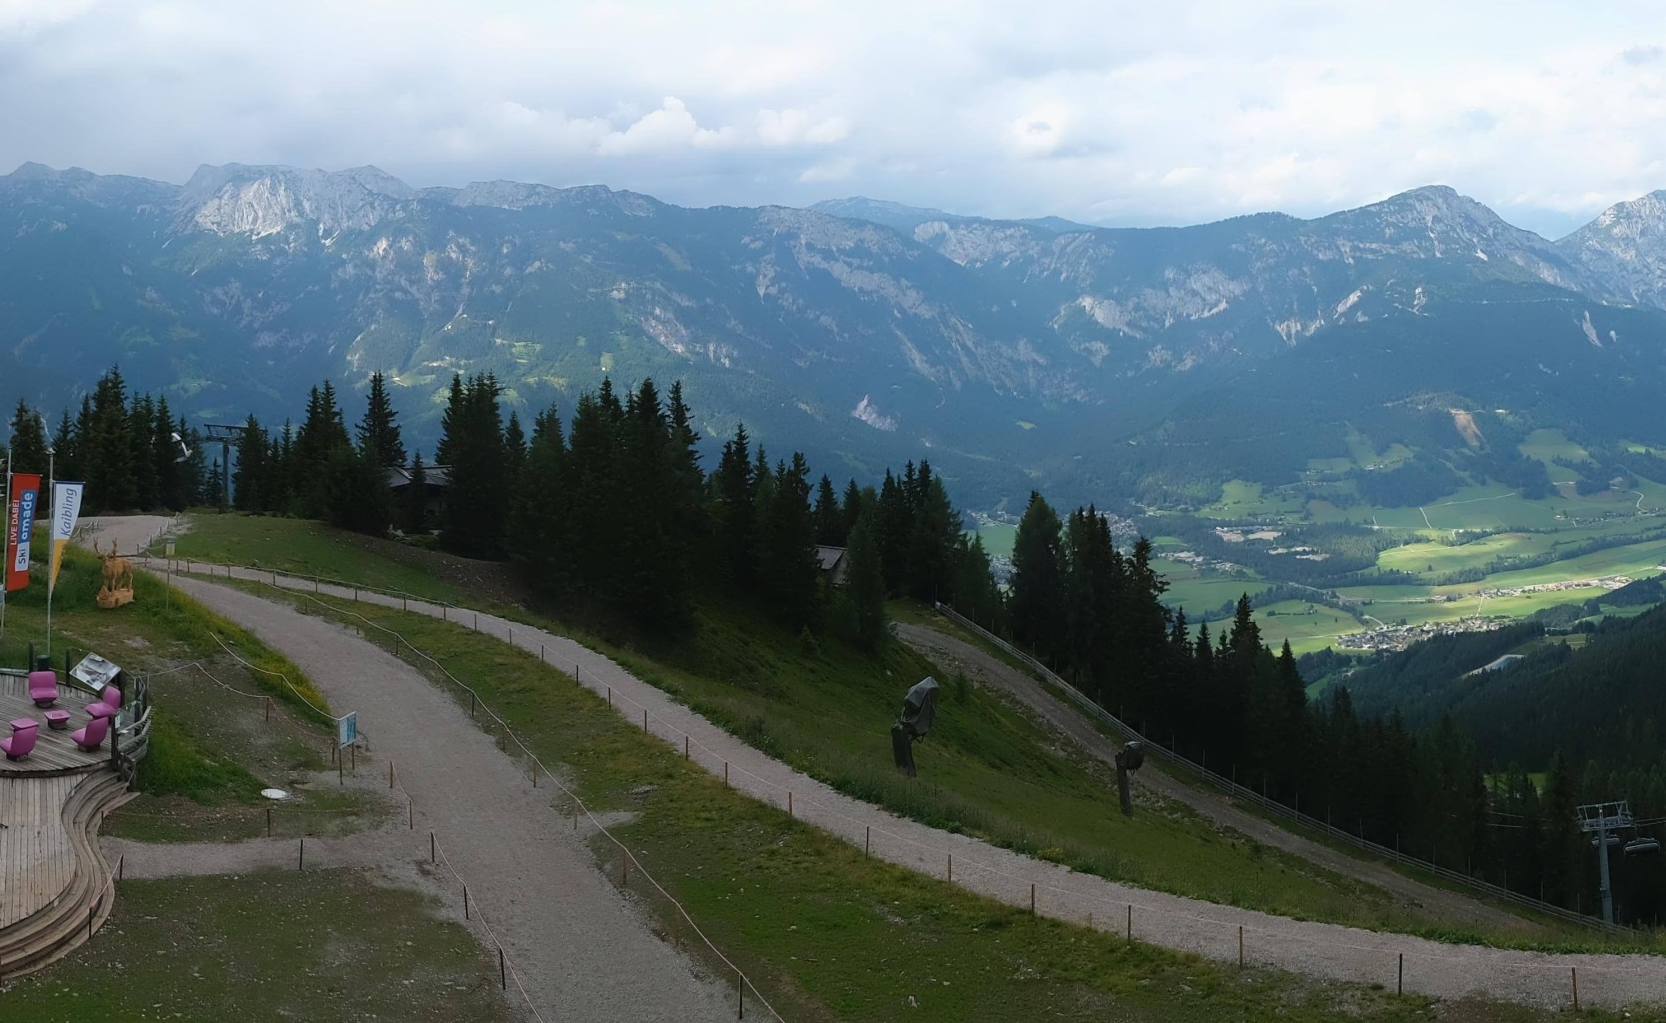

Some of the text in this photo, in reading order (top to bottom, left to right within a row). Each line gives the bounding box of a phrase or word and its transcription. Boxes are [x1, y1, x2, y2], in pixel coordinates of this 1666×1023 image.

[10, 499, 20, 545] LIVE DABEI
[61, 488, 77, 537] Kaibling
